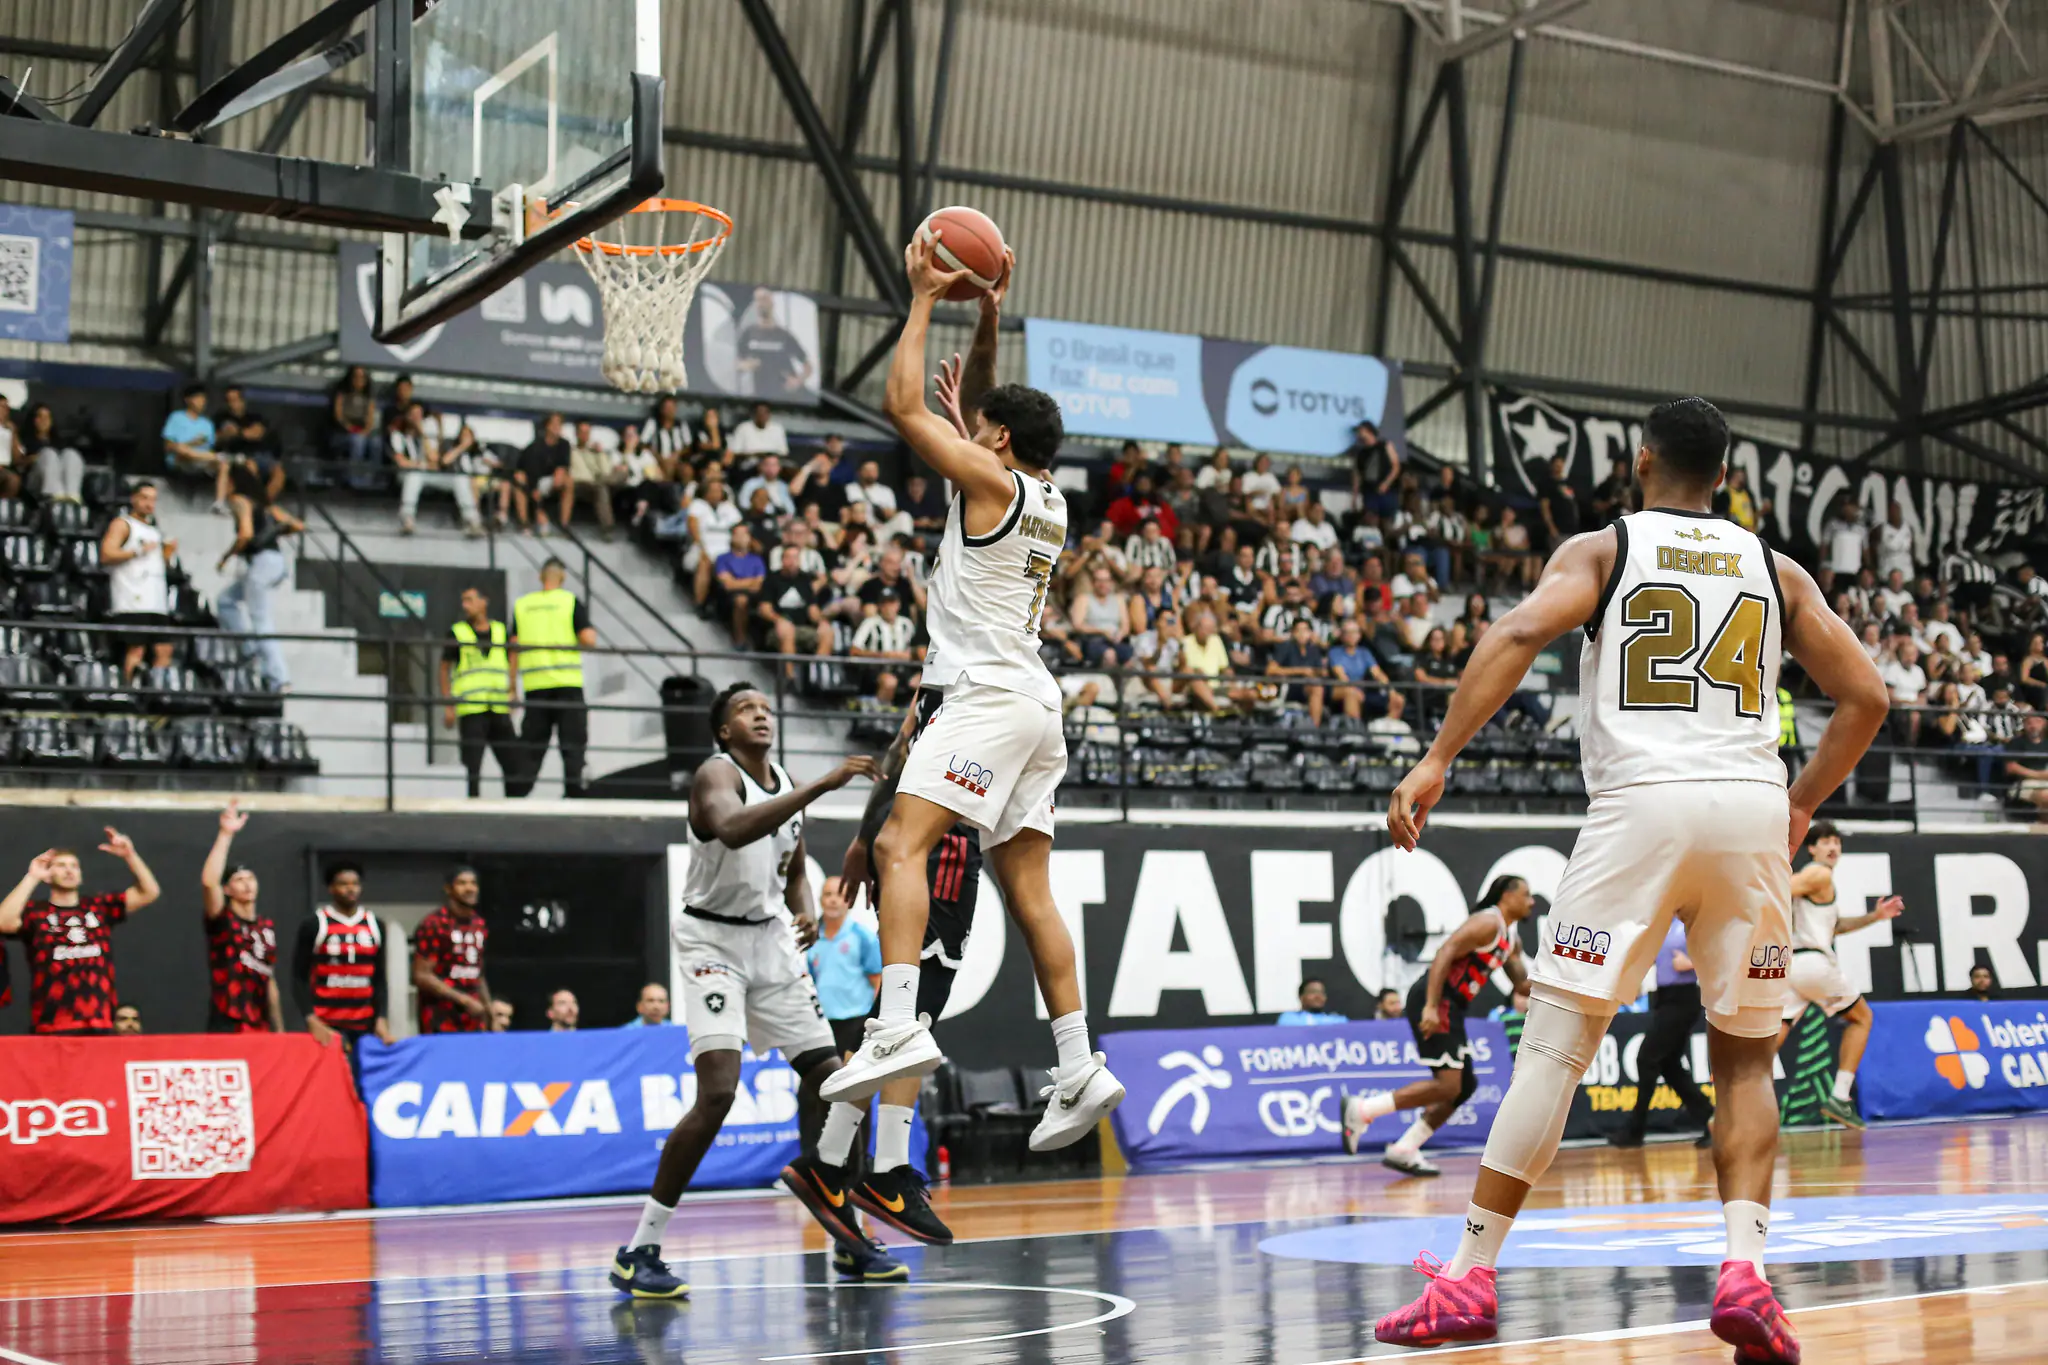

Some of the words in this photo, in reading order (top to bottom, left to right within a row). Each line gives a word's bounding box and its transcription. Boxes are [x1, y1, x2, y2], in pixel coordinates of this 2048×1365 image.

[1072, 339, 1130, 364] Brasil
[1285, 387, 1367, 420] TOTVS
[1656, 545, 1744, 578] DERICK
[1619, 581, 1769, 721] 24
[953, 774, 983, 794] PET
[1555, 921, 1612, 955] UPA
[1561, 947, 1597, 963] PET
[1759, 969, 1783, 979] PET
[1239, 1037, 1367, 1072] FORMAÇÃO
[1371, 1040, 1400, 1065] DE
[372, 1080, 622, 1140] CAIXA
